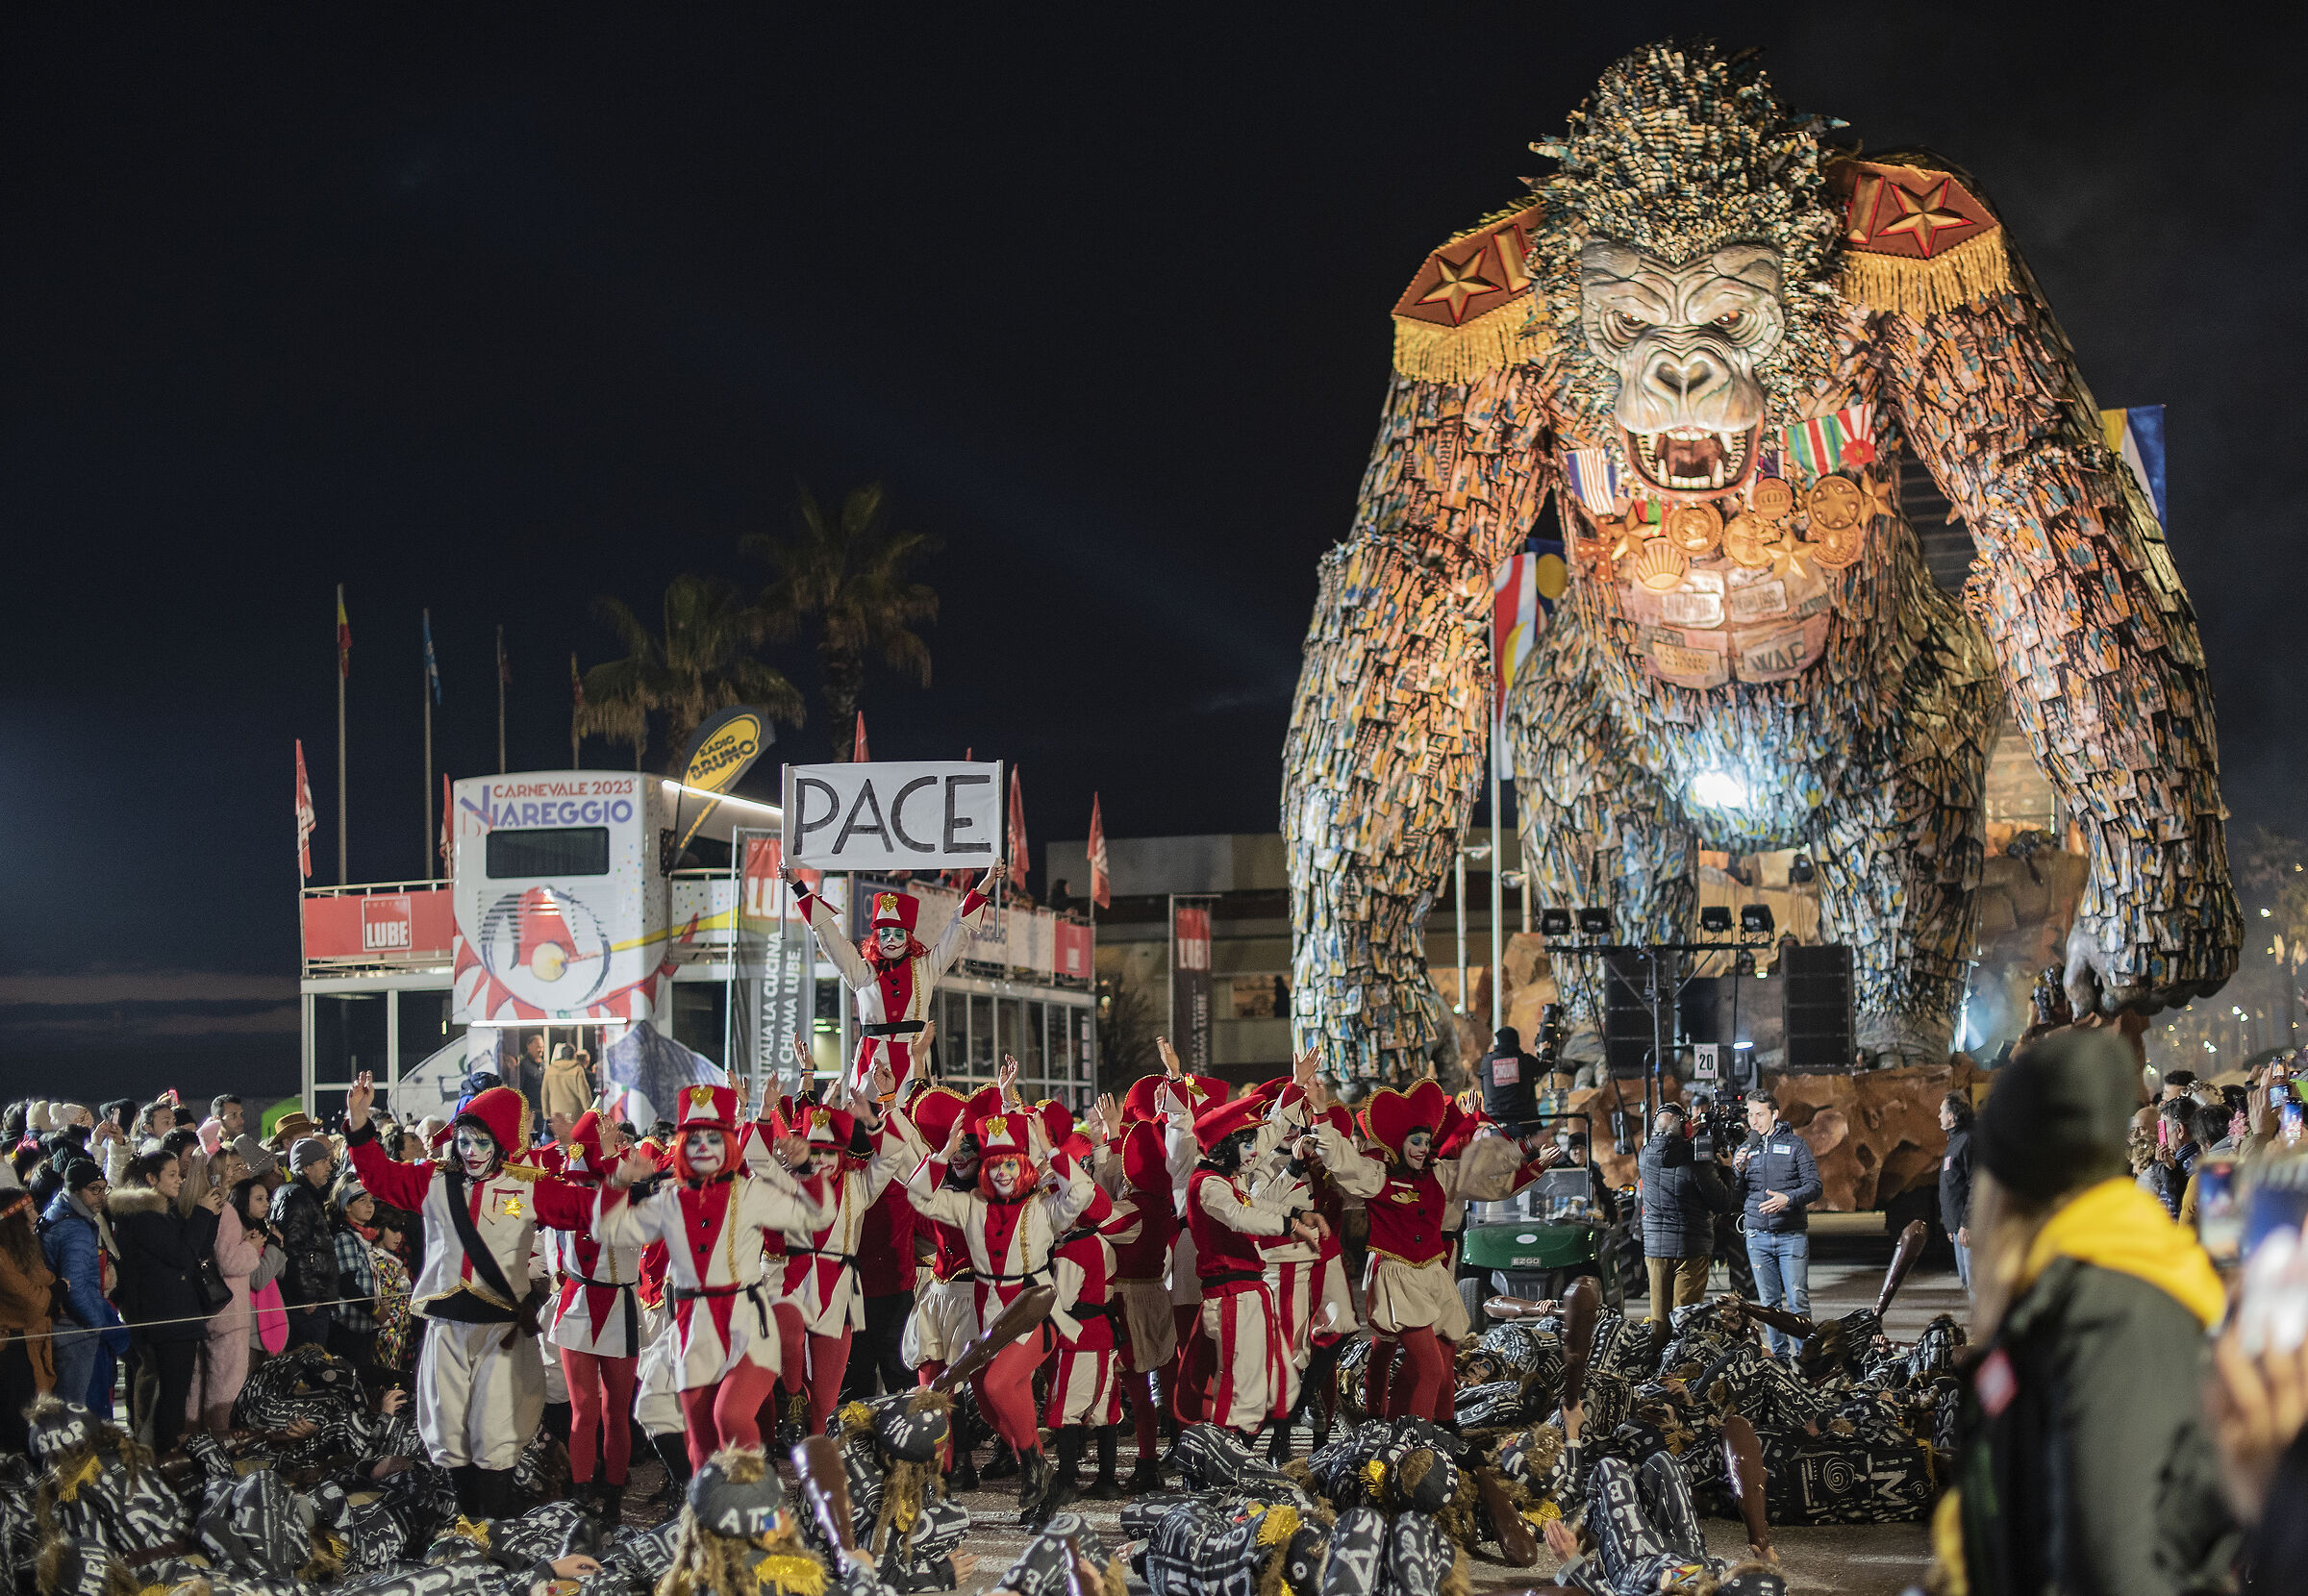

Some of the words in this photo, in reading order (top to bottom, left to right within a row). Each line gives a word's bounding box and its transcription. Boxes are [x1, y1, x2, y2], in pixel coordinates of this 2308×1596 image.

[699, 735, 735, 758] RADIO
[493, 783, 588, 798] CARNEVALE
[591, 781, 633, 795] 2023
[460, 785, 633, 827] VIAREGGIO
[792, 775, 991, 856] PACE
[366, 921, 409, 948] LUBE
[764, 931, 781, 998] CUCINA
[763, 1001, 777, 1021] LA
[779, 997, 797, 1063] CHIAMA
[1699, 1054, 1714, 1070] 20
[778, 1068, 792, 1084] SI
